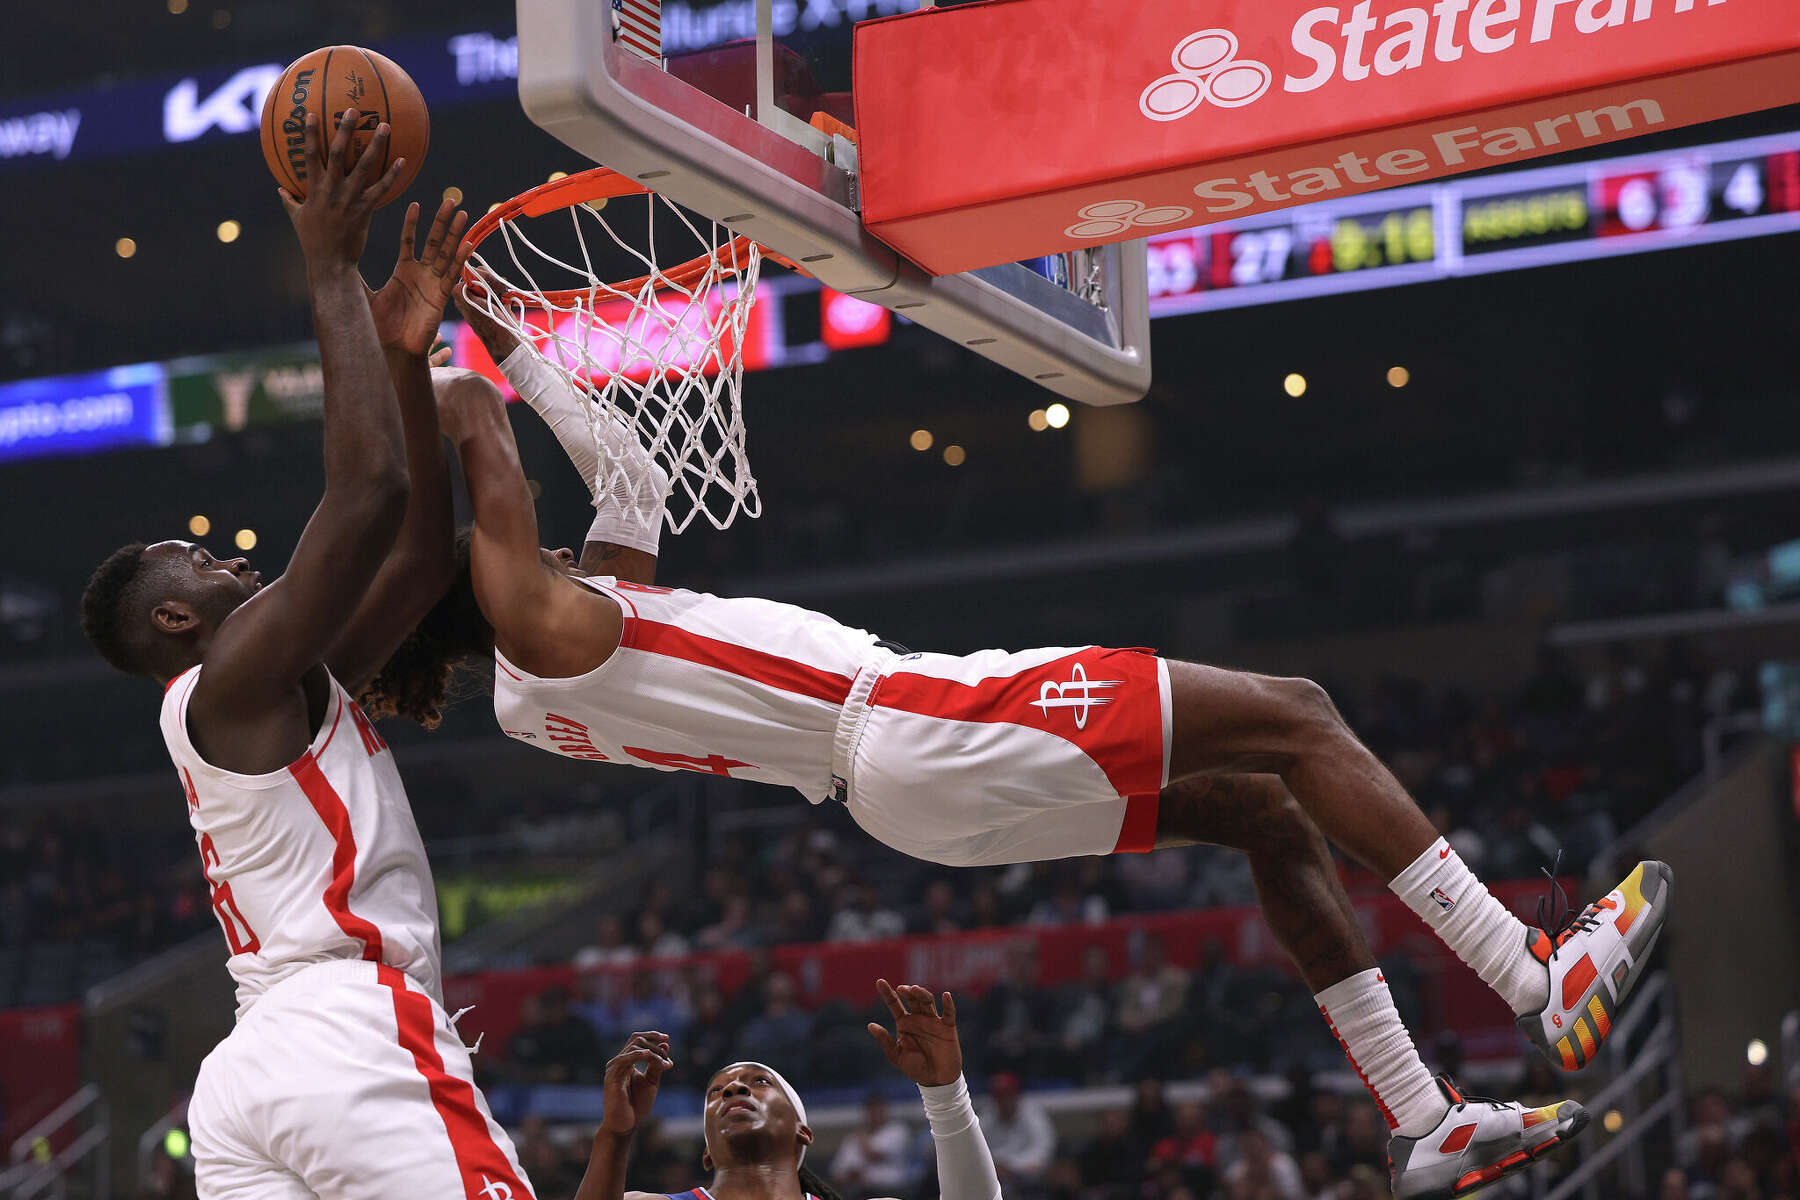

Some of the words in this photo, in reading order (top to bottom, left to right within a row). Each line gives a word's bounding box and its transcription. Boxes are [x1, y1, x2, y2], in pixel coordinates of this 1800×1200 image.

[1283, 0, 1521, 93] State
[1194, 148, 1430, 213] State
[1432, 99, 1665, 166] Farm
[0, 392, 134, 448] pto.com
